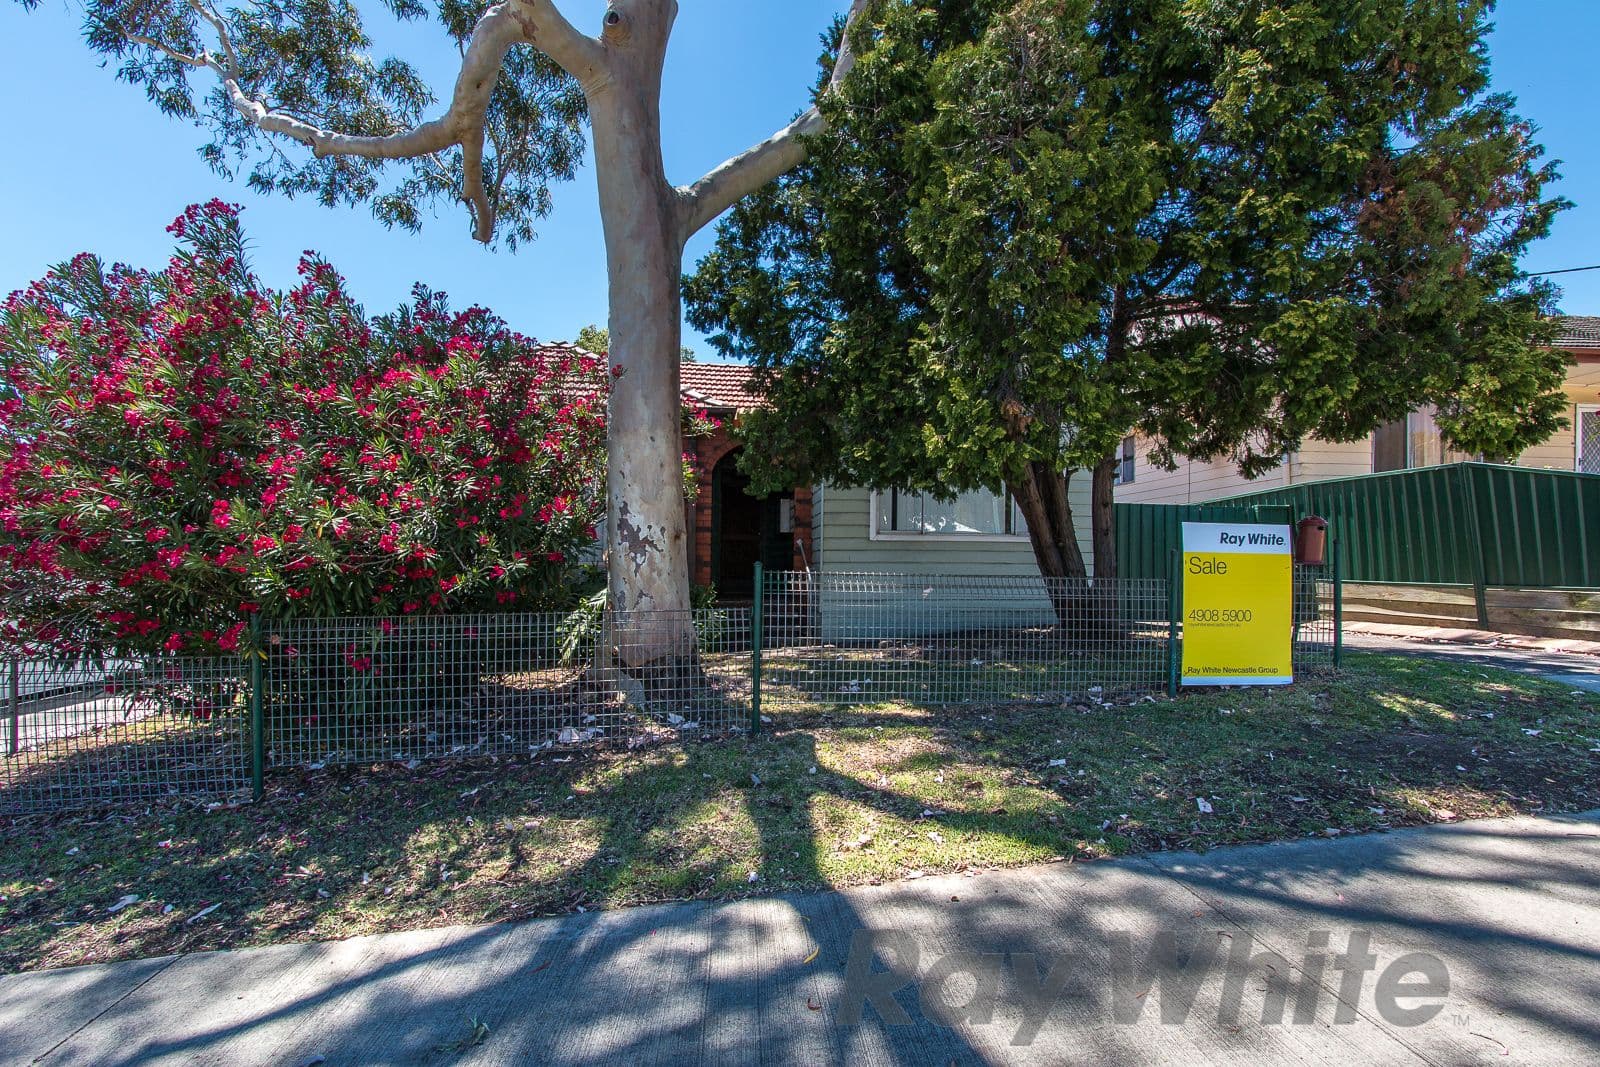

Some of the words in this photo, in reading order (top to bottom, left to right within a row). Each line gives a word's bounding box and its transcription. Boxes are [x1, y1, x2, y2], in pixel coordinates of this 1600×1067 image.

[1220, 532, 1246, 546] Ray
[1189, 556, 1227, 575] Sale
[1188, 609, 1219, 622] 4908
[1222, 609, 1252, 622] 5900
[1187, 666, 1201, 674] Ray
[1202, 666, 1221, 674] White
[1223, 666, 1257, 674] Newcastle
[1258, 666, 1279, 675] Group
